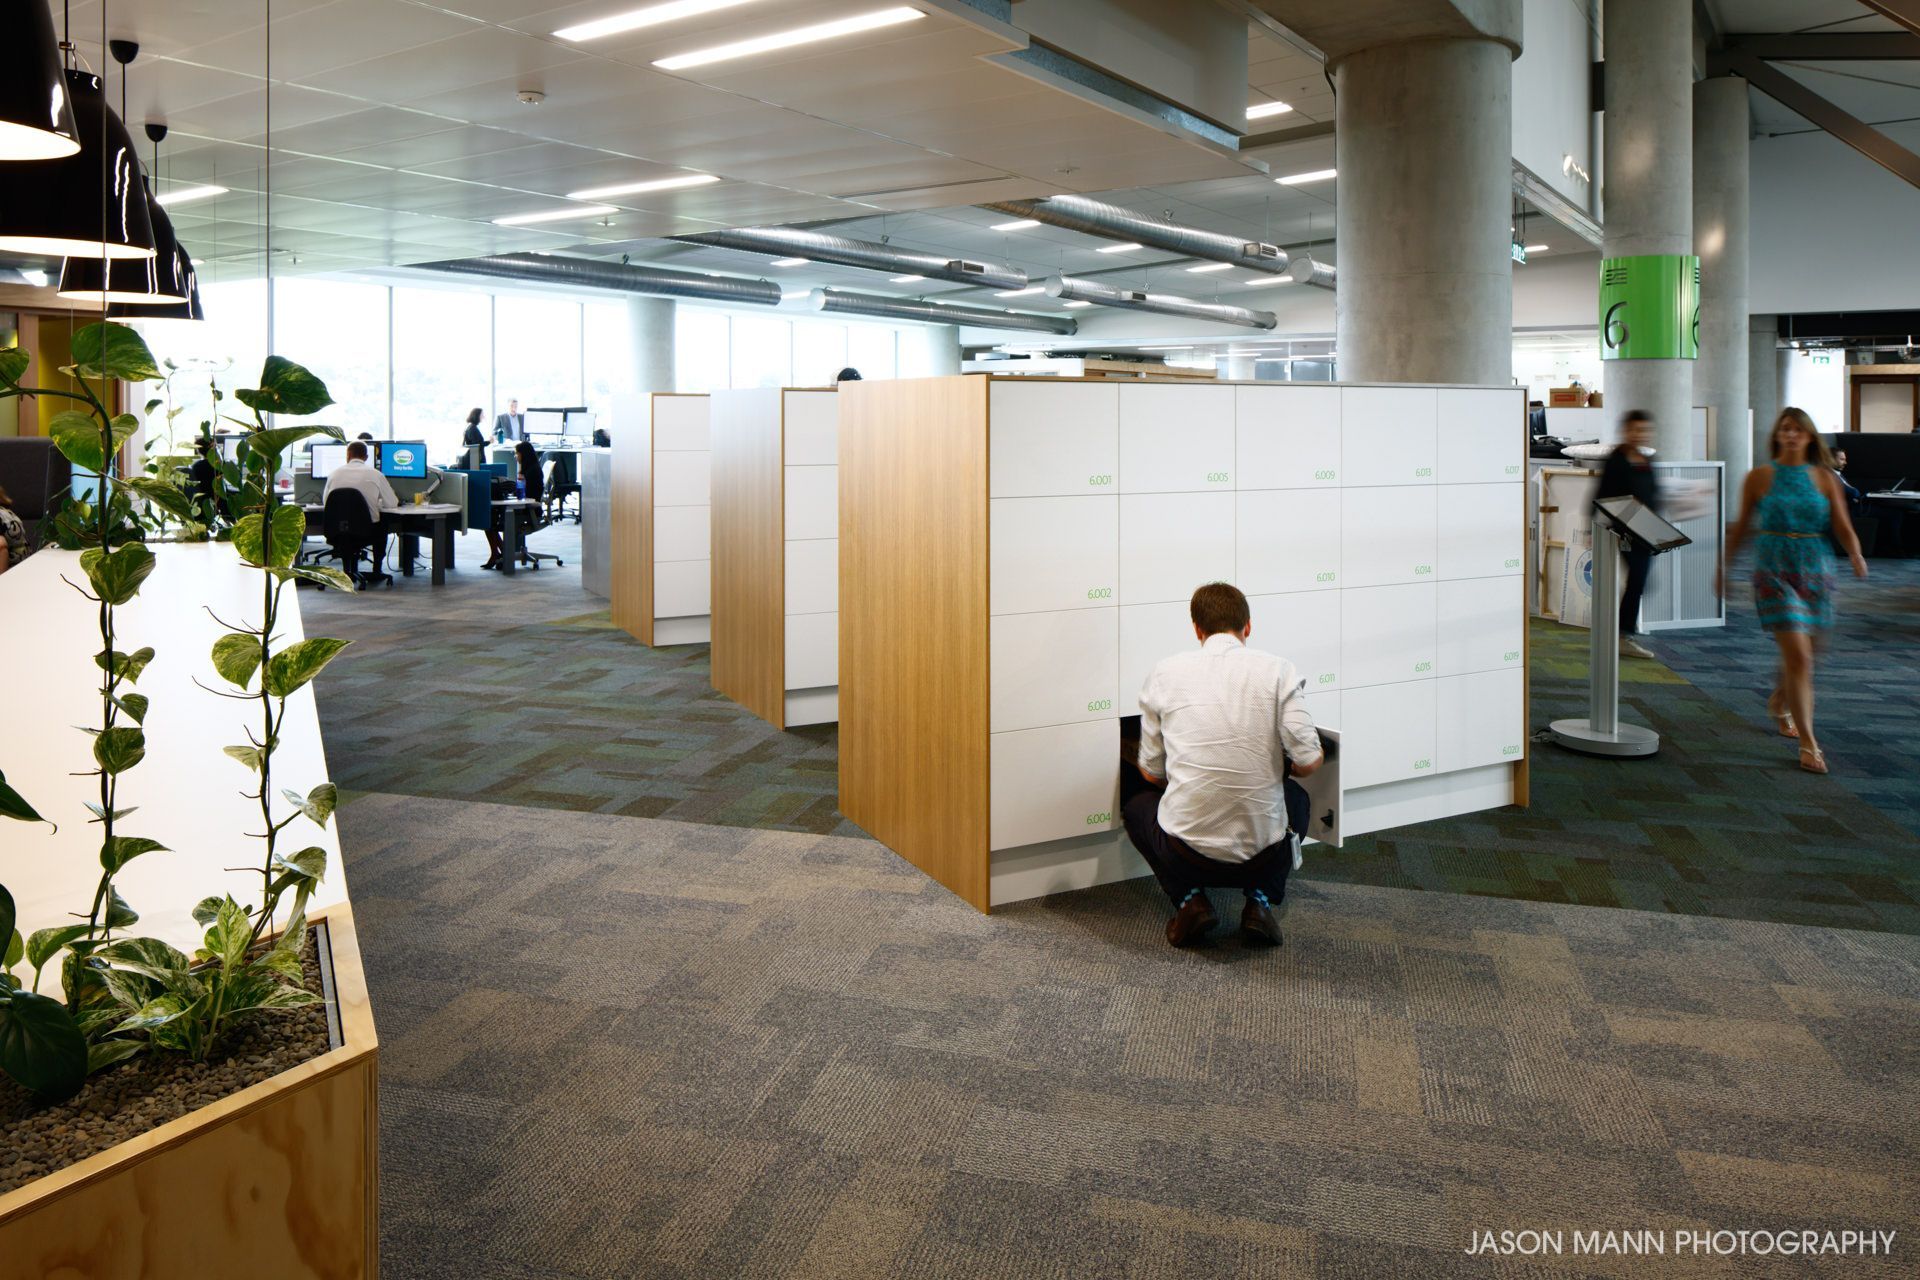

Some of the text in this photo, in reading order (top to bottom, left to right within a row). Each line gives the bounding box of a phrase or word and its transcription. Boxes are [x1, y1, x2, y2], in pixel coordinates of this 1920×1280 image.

[1604, 300, 1629, 349] 6
[1088, 474, 1113, 486] 6.001
[1206, 471, 1230, 483] 6.005
[1314, 469, 1336, 480] 6.009
[1413, 564, 1433, 575] 6.014
[1315, 571, 1337, 583] 6.010
[1086, 586, 1113, 600] 6.002
[1318, 673, 1336, 684] 6.011
[1086, 698, 1112, 712] 6.003
[1502, 744, 1520, 756] 6.020
[1413, 758, 1432, 770] 6.016
[1085, 812, 1112, 825] 6.004
